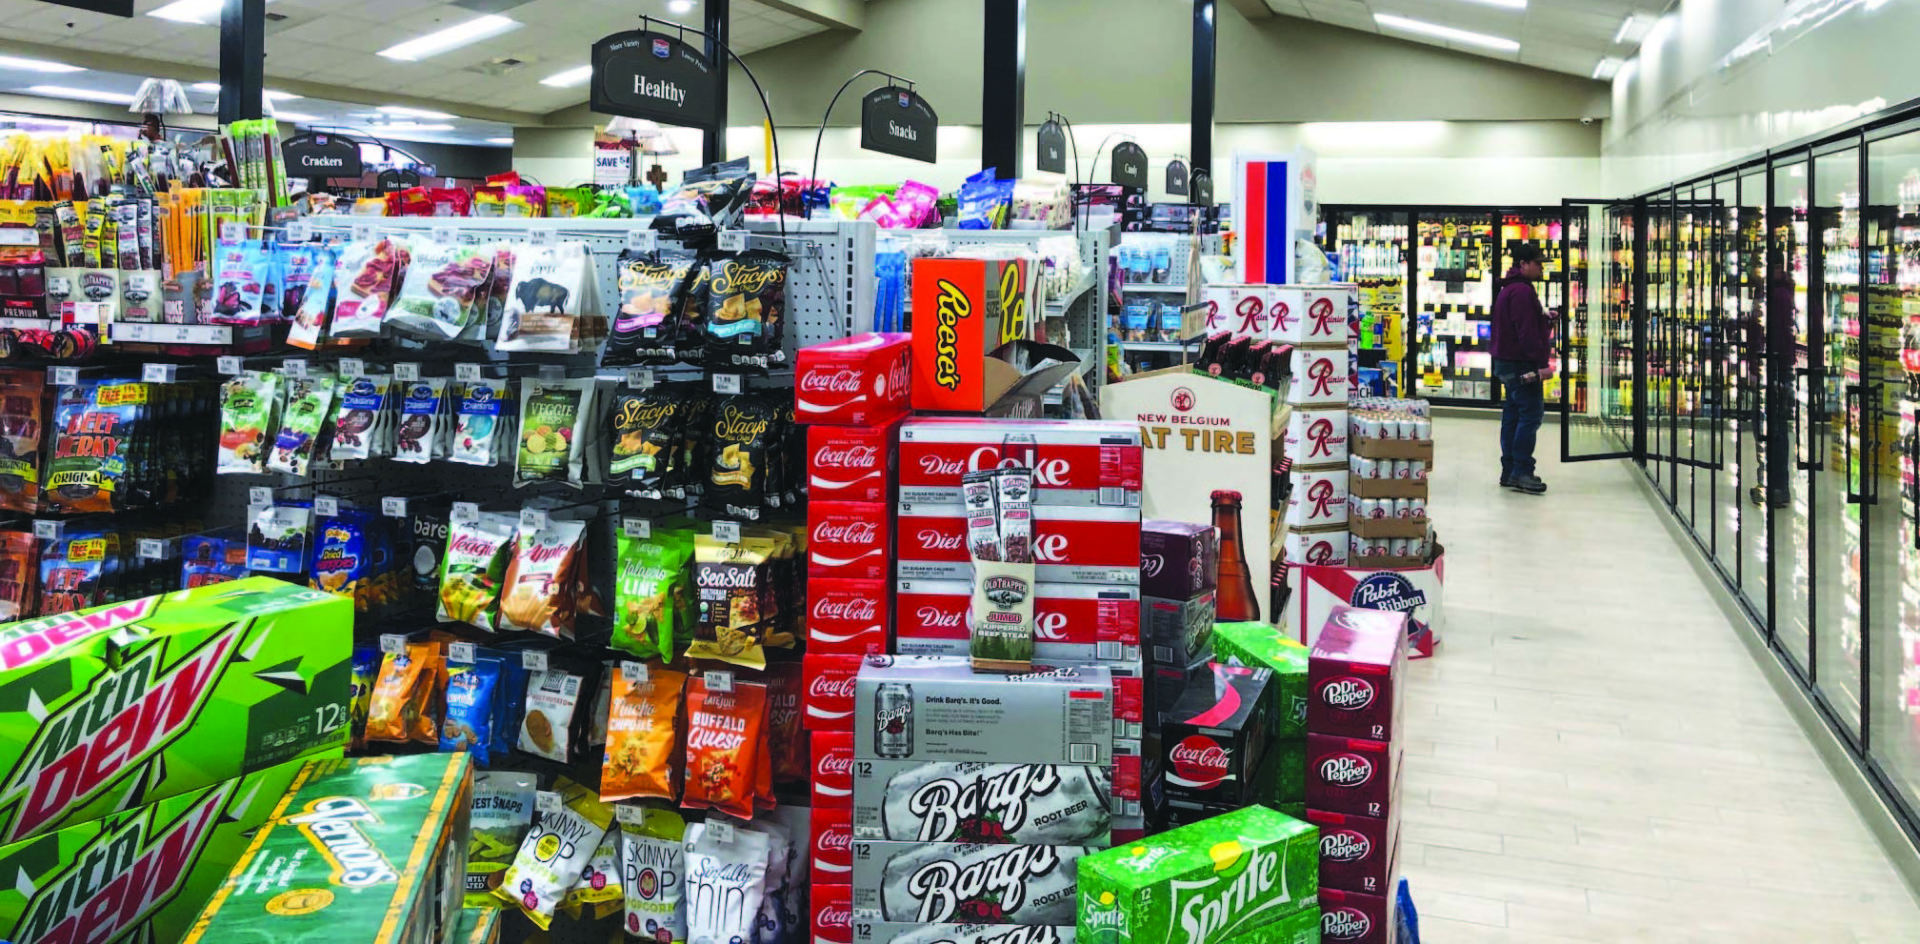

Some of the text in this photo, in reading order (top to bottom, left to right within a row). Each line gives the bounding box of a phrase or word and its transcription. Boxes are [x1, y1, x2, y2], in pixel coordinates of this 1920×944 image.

[634, 74, 686, 107] Healthy
[889, 120, 917, 141] Snacks
[302, 155, 343, 167] Crackers
[596, 157, 618, 167] SAVE
[619, 261, 688, 293] Stacy's
[711, 261, 778, 294] Stacy's
[4, 308, 38, 318] PREMIUM
[1308, 297, 1346, 337] Rainier
[936, 279, 971, 391] Reese's
[801, 369, 864, 392] Coca-Cola
[1307, 357, 1346, 397] Rainier
[343, 395, 376, 407] Craisins
[404, 401, 432, 411] Craisins
[463, 401, 494, 411] Craisins
[531, 402, 575, 417] VEGGIE
[615, 399, 677, 430] Stacy's
[715, 404, 769, 445] Stacy's
[1137, 413, 1231, 426] NEW BELGIUM
[904, 431, 914, 439] 12
[1180, 428, 1256, 455] TIRE
[1306, 418, 1346, 458] Rainier
[55, 435, 121, 459] JERKY
[813, 446, 880, 468] Coca-Cola
[919, 454, 965, 475] Diet
[1306, 479, 1347, 519] Rainier
[414, 515, 449, 539] bare
[813, 520, 879, 544] Coca-Cola
[450, 532, 498, 557] Veggie
[917, 529, 963, 549] Diet
[521, 543, 571, 563] Apple
[902, 582, 911, 590] 12
[985, 578, 1027, 593] OLD TRAPPER
[1359, 580, 1400, 605] Pabst
[813, 597, 879, 620] Coca-Cola
[1377, 594, 1424, 612] Ribbon
[916, 606, 963, 627] Diet
[988, 612, 1021, 623] JUMBO
[810, 674, 857, 697] Coca-C
[1323, 682, 1370, 706] Pepper
[1340, 680, 1359, 692] Dr
[926, 696, 944, 704] Drink
[945, 697, 968, 705] Barq's.
[982, 697, 1002, 705] Good.
[316, 702, 341, 734] 12
[692, 711, 746, 732] BUFFALO
[877, 701, 912, 732] Barq's
[687, 727, 747, 750] Queso
[1371, 725, 1384, 735] 12
[817, 753, 853, 775] Coca-
[1169, 743, 1233, 769] Coca-Cola
[1339, 757, 1357, 768] Dr
[858, 762, 872, 774] 12
[963, 765, 986, 776] SINCE
[1321, 759, 1369, 783] Pepper
[493, 795, 523, 813] SNAPS
[1033, 800, 1089, 827] ROOT BEER
[1368, 803, 1381, 812] 12
[290, 796, 399, 887] Vernors
[523, 822, 575, 868] POP
[817, 829, 853, 851] Coca-
[856, 844, 871, 856] 12
[1320, 835, 1368, 858] Pepper
[1337, 833, 1355, 845] Dr
[628, 840, 678, 869] SKINNY
[962, 845, 985, 857] SINCE
[467, 875, 487, 883] HTLY
[626, 863, 676, 901] POP
[694, 857, 751, 887] Sinfully
[1364, 877, 1376, 887] 12
[1032, 885, 1078, 907] ROOT BE
[1141, 888, 1151, 900] 12
[1180, 846, 1278, 944] Sprite
[686, 874, 746, 939] thin
[816, 906, 852, 928] Coca-
[1085, 904, 1125, 930] Sprite
[1336, 910, 1355, 922] Dr
[857, 924, 871, 936] 12
[1320, 911, 1367, 936] Pepper
